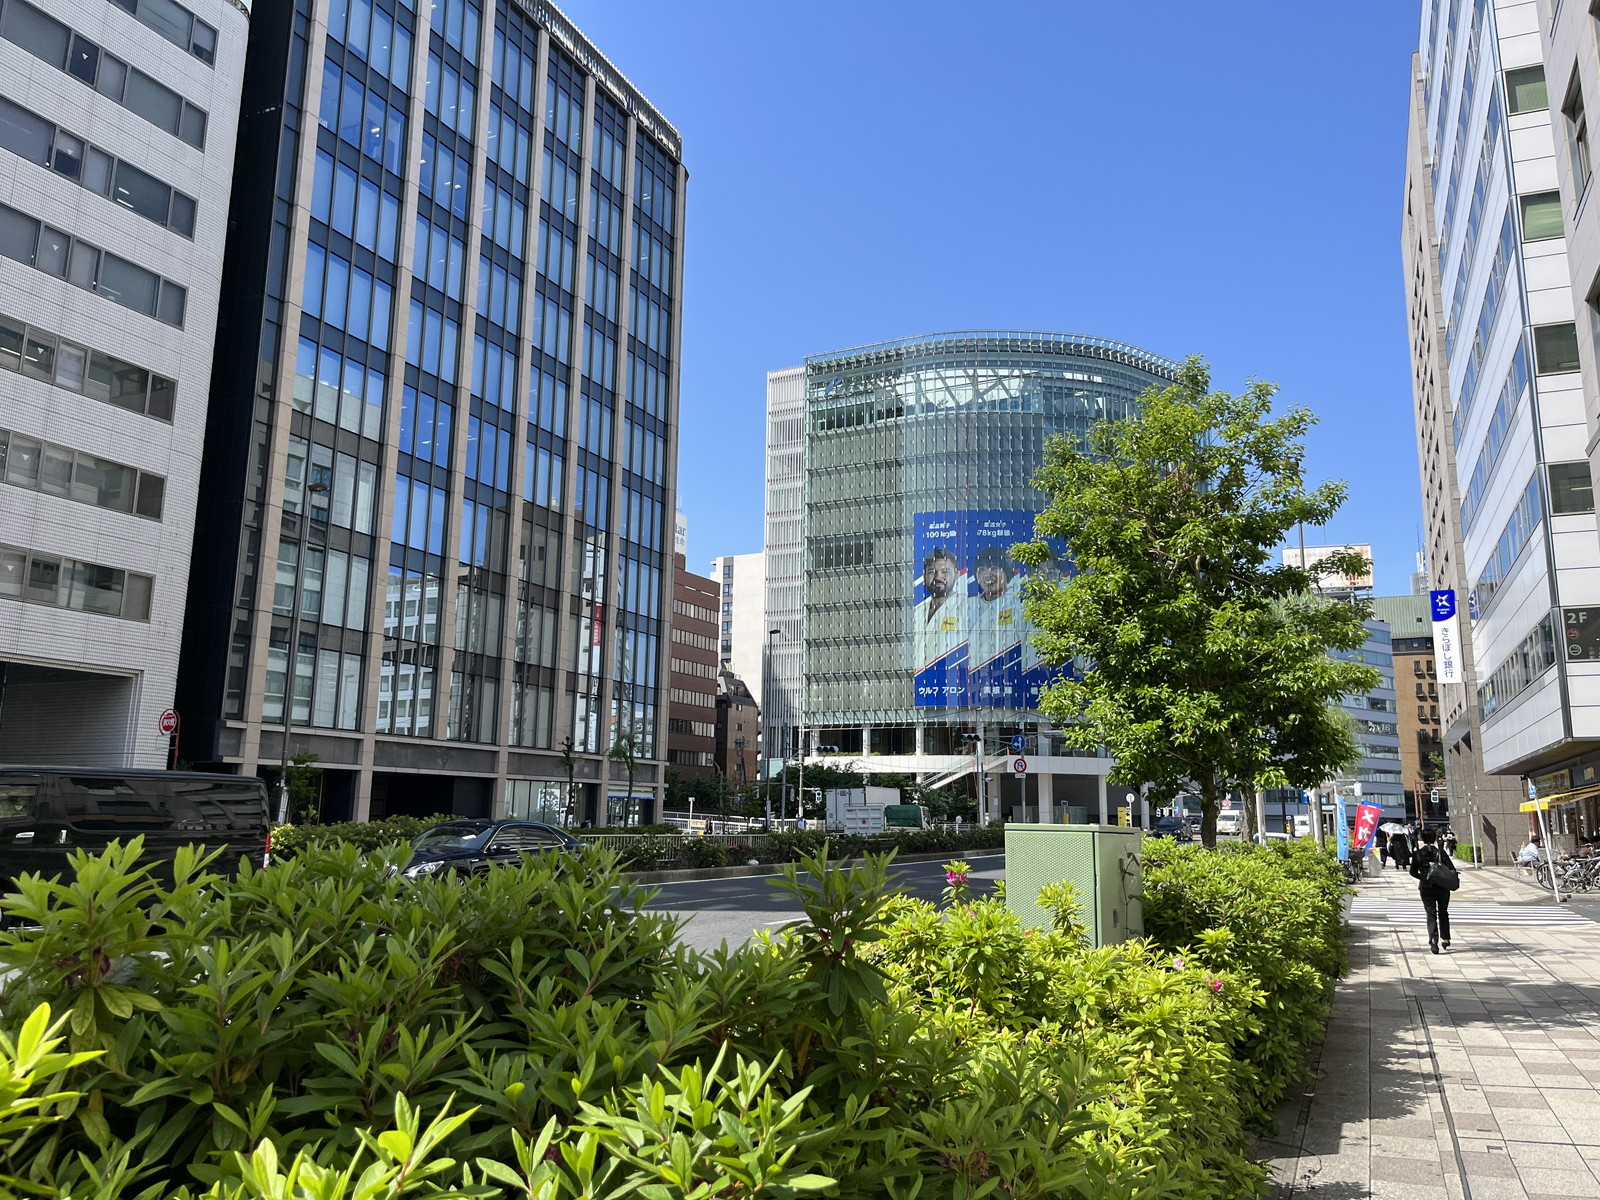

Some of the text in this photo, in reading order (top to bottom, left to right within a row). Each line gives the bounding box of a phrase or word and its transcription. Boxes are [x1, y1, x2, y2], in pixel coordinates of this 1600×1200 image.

[1567, 611, 1588, 624] 2F
[1441, 627, 1454, 678] きらぼし銀行
[918, 686, 965, 695] ウルフ アロン
